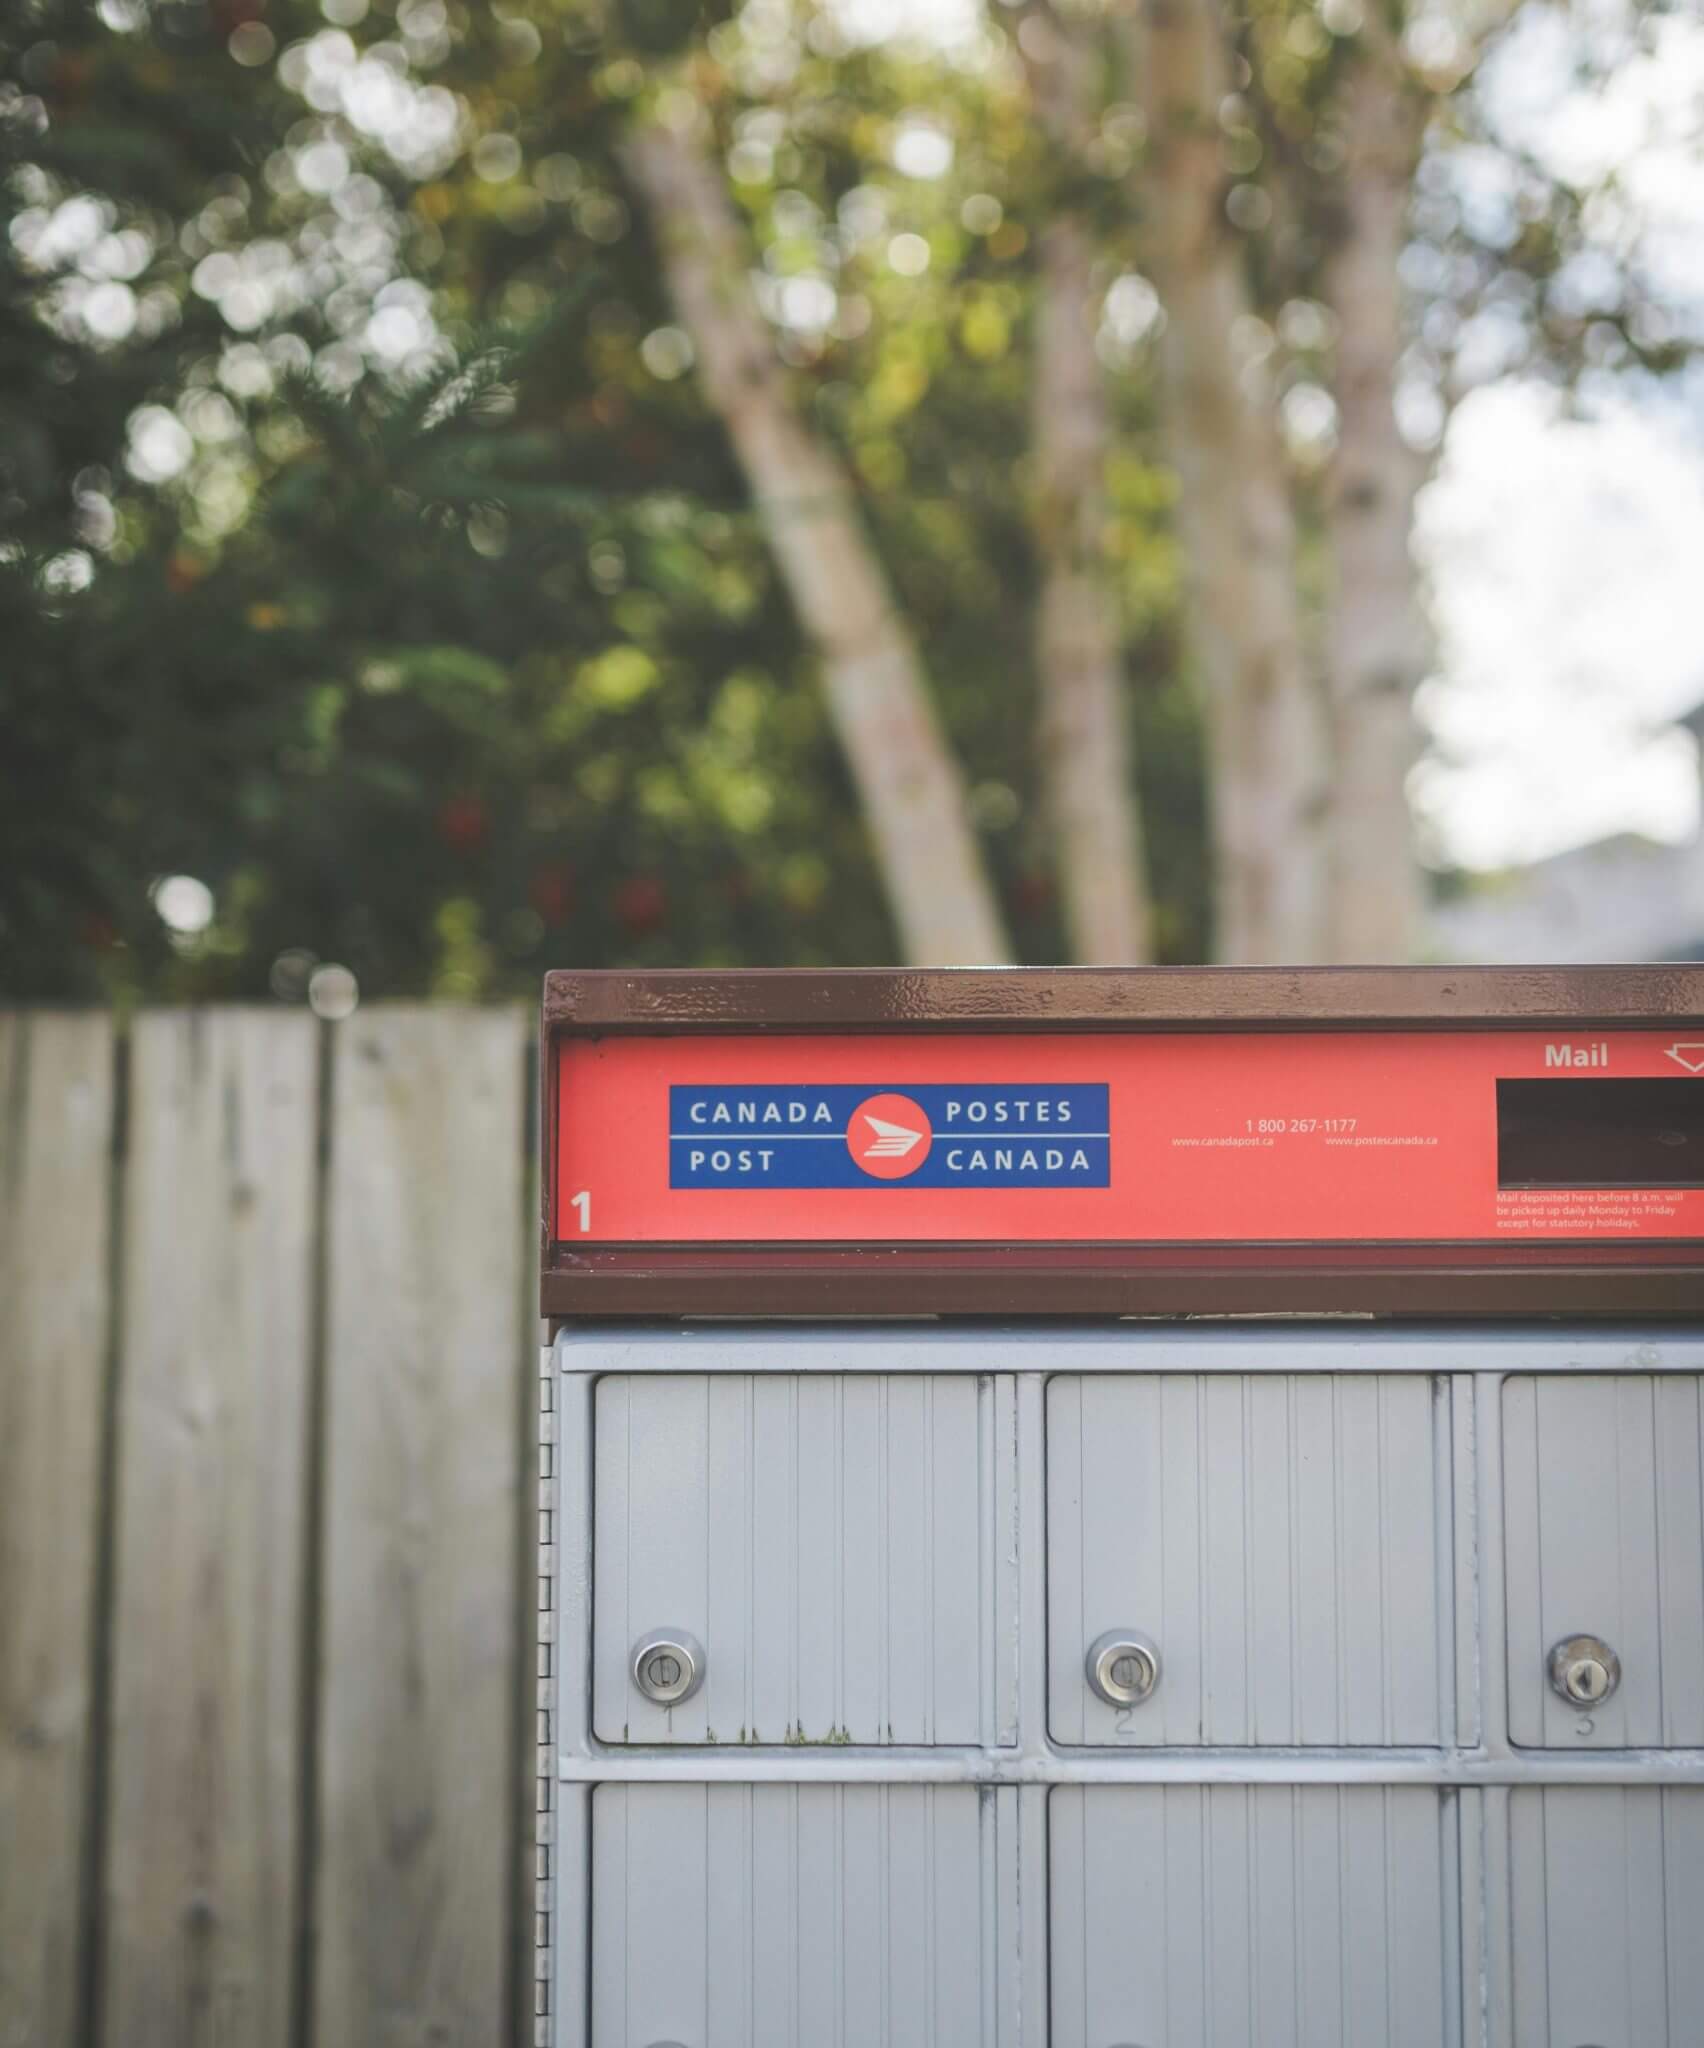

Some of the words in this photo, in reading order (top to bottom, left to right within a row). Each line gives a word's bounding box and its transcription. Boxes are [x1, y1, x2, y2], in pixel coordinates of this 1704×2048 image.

[1545, 1042, 1609, 1067] Mail
[689, 1102, 833, 1124] CANADA
[946, 1101, 1073, 1122] POSTES
[1245, 1119, 1253, 1133] 1
[1258, 1119, 1286, 1133] 800
[1290, 1119, 1357, 1133] 267-1177
[1171, 1136, 1274, 1148] www.canadapost.ca
[1325, 1135, 1438, 1147] www.postescanada.ca
[689, 1150, 775, 1172] POST
[946, 1150, 1090, 1171] CANADA
[1497, 1192, 1518, 1203] Mail
[1520, 1193, 1569, 1205] deposited
[1572, 1193, 1597, 1203] here
[1598, 1193, 1630, 1203] before
[1664, 1192, 1684, 1201] will
[570, 1191, 591, 1232] 1
[1497, 1206, 1509, 1216] be
[1511, 1206, 1544, 1218] picked
[1547, 1208, 1560, 1217] up
[1563, 1205, 1587, 1218] daily
[1588, 1205, 1629, 1217] Monday
[1632, 1206, 1642, 1214] to
[1645, 1205, 1676, 1217] Friday
[1497, 1219, 1529, 1230] except
[1532, 1218, 1546, 1228] for
[1549, 1218, 1594, 1230] statutory
[1596, 1217, 1640, 1229] holidays.
[663, 1702, 673, 1733] 1
[1115, 1707, 1137, 1734] 2
[1576, 1711, 1595, 1736] 3
